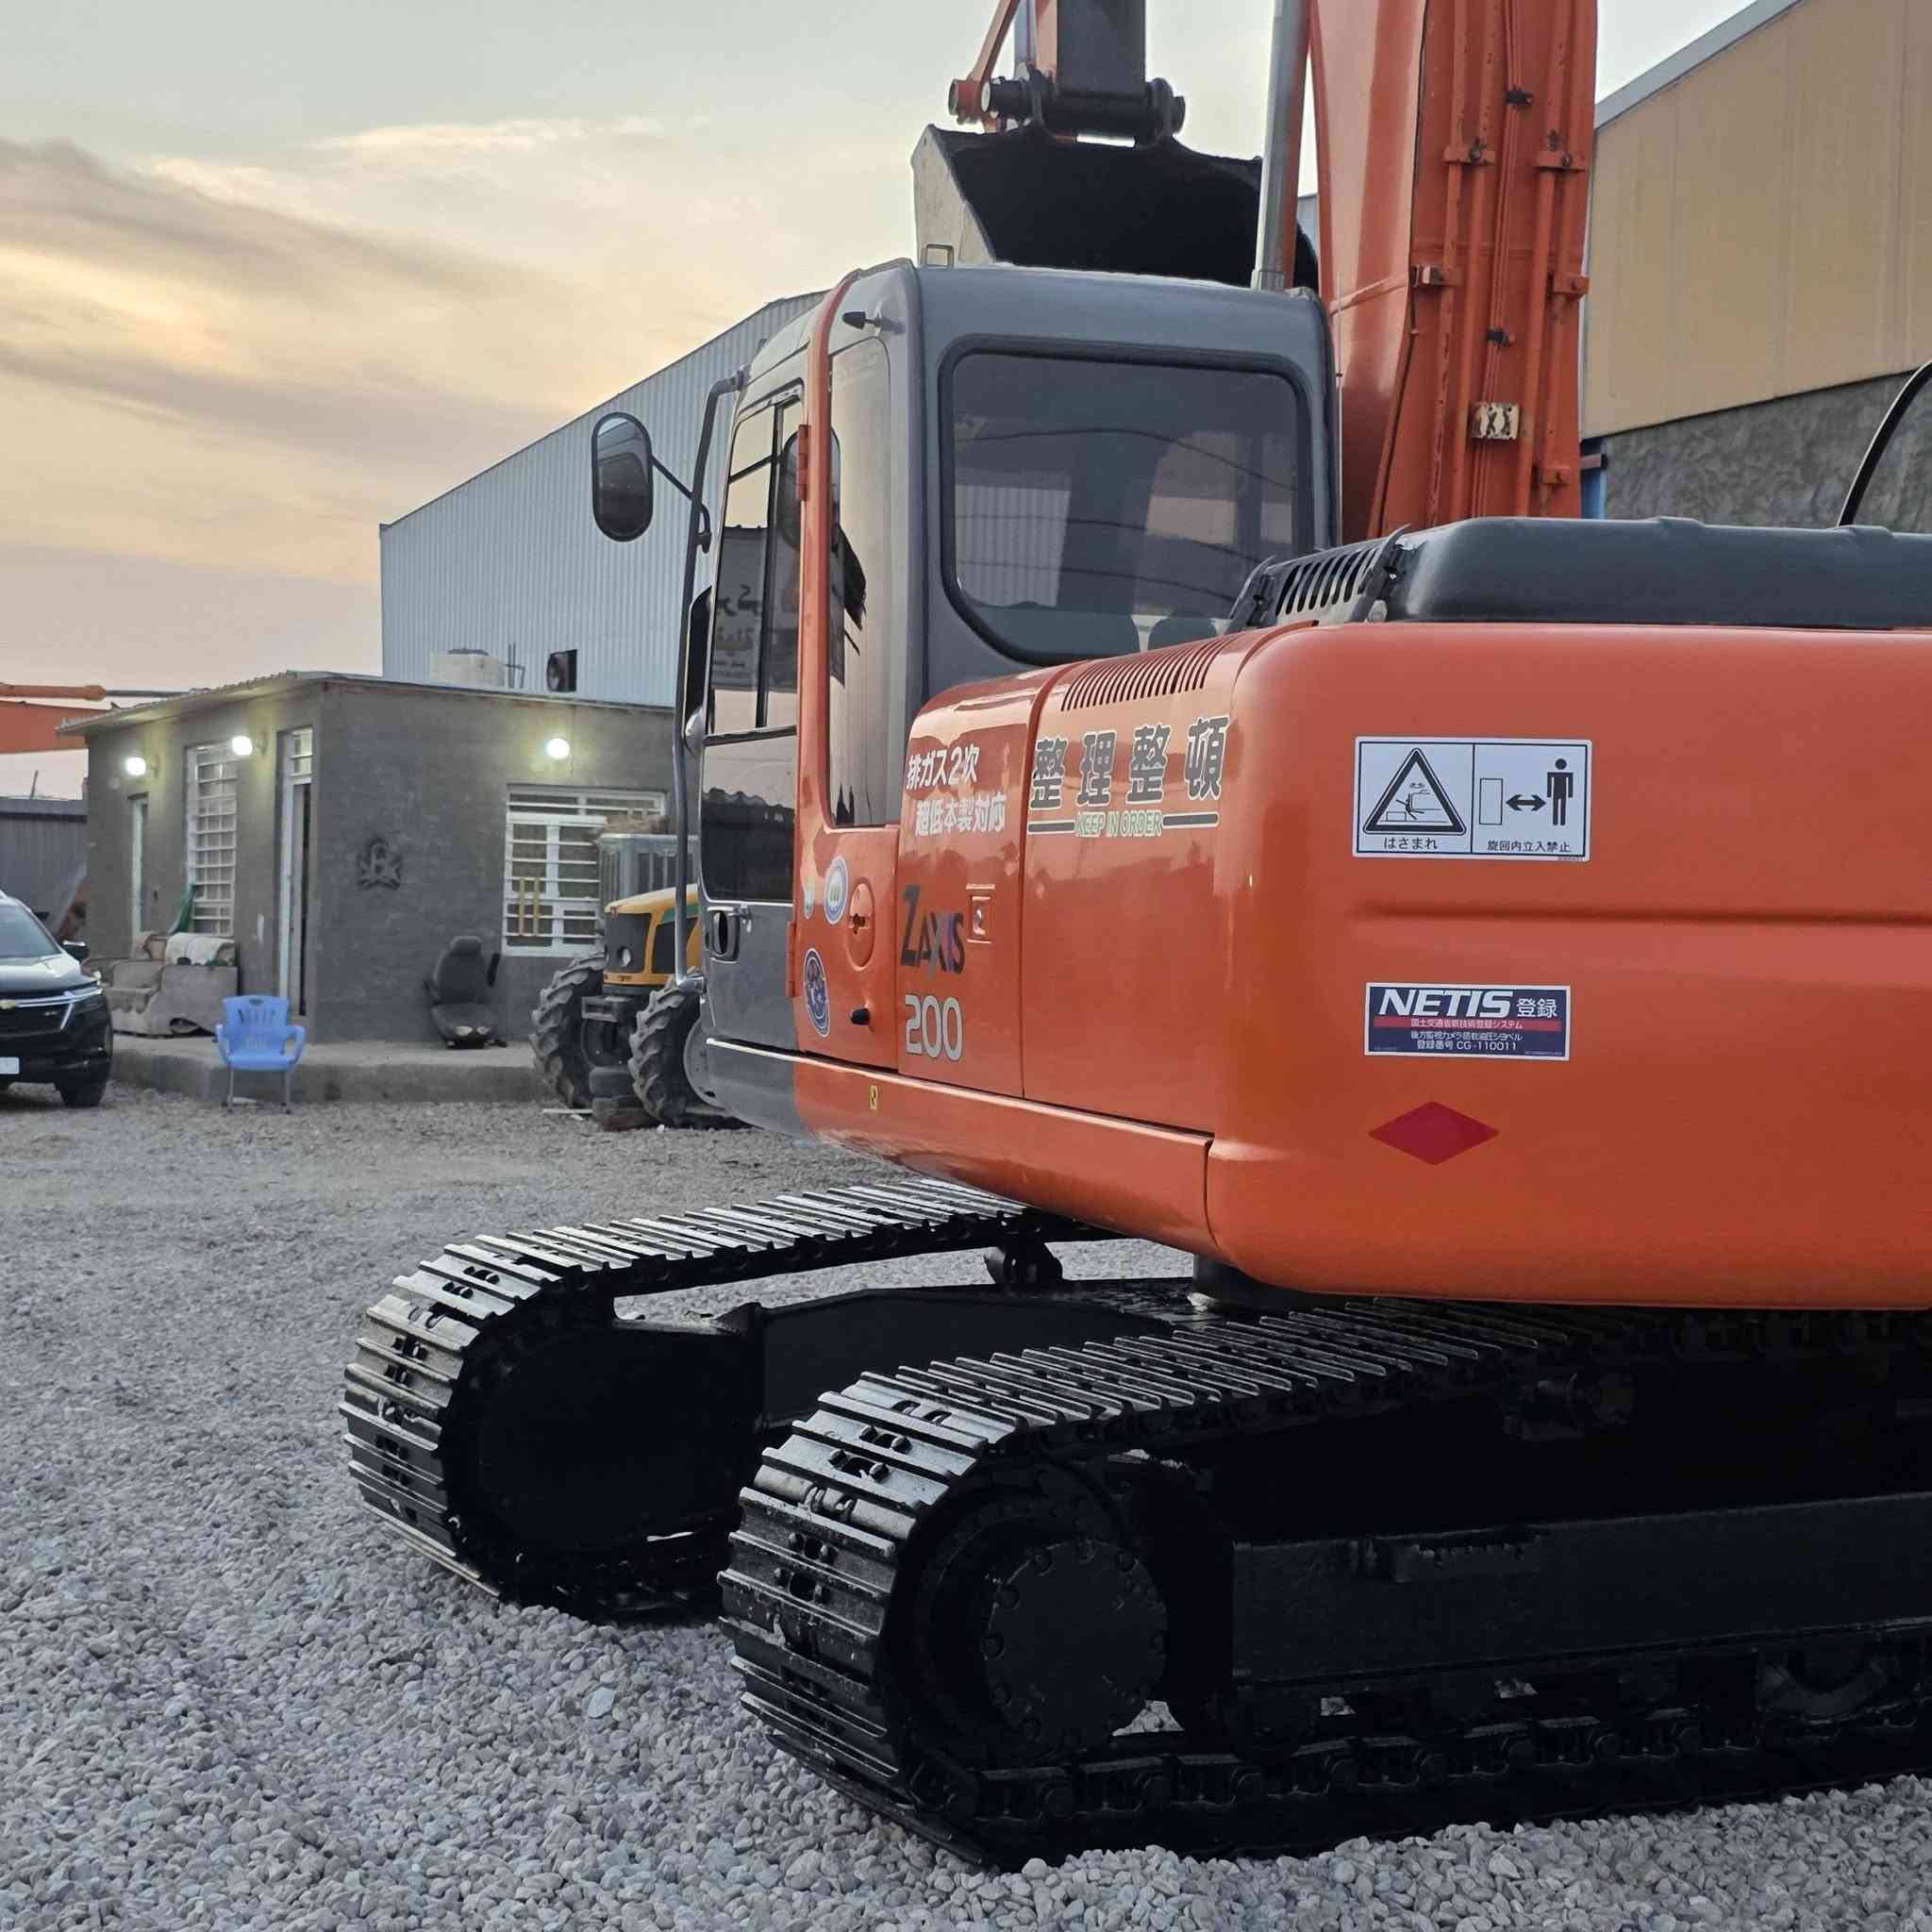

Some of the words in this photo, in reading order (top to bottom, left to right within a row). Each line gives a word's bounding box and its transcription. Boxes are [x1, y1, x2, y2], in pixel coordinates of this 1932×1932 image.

[906, 743, 980, 791] 排ガス2次
[1029, 715, 1229, 810] 整理整頓
[1074, 810, 1106, 838] KEEP
[1107, 809, 1119, 837] IN
[1120, 808, 1163, 837] ORDER
[1384, 837, 1438, 850] はさまれ
[1488, 840, 1571, 853] 旋回内立入禁止
[1378, 988, 1513, 1019] NETIS
[1516, 998, 1557, 1019] 登録
[905, 993, 964, 1062] 200
[1457, 1041, 1517, 1051] CG-110011
